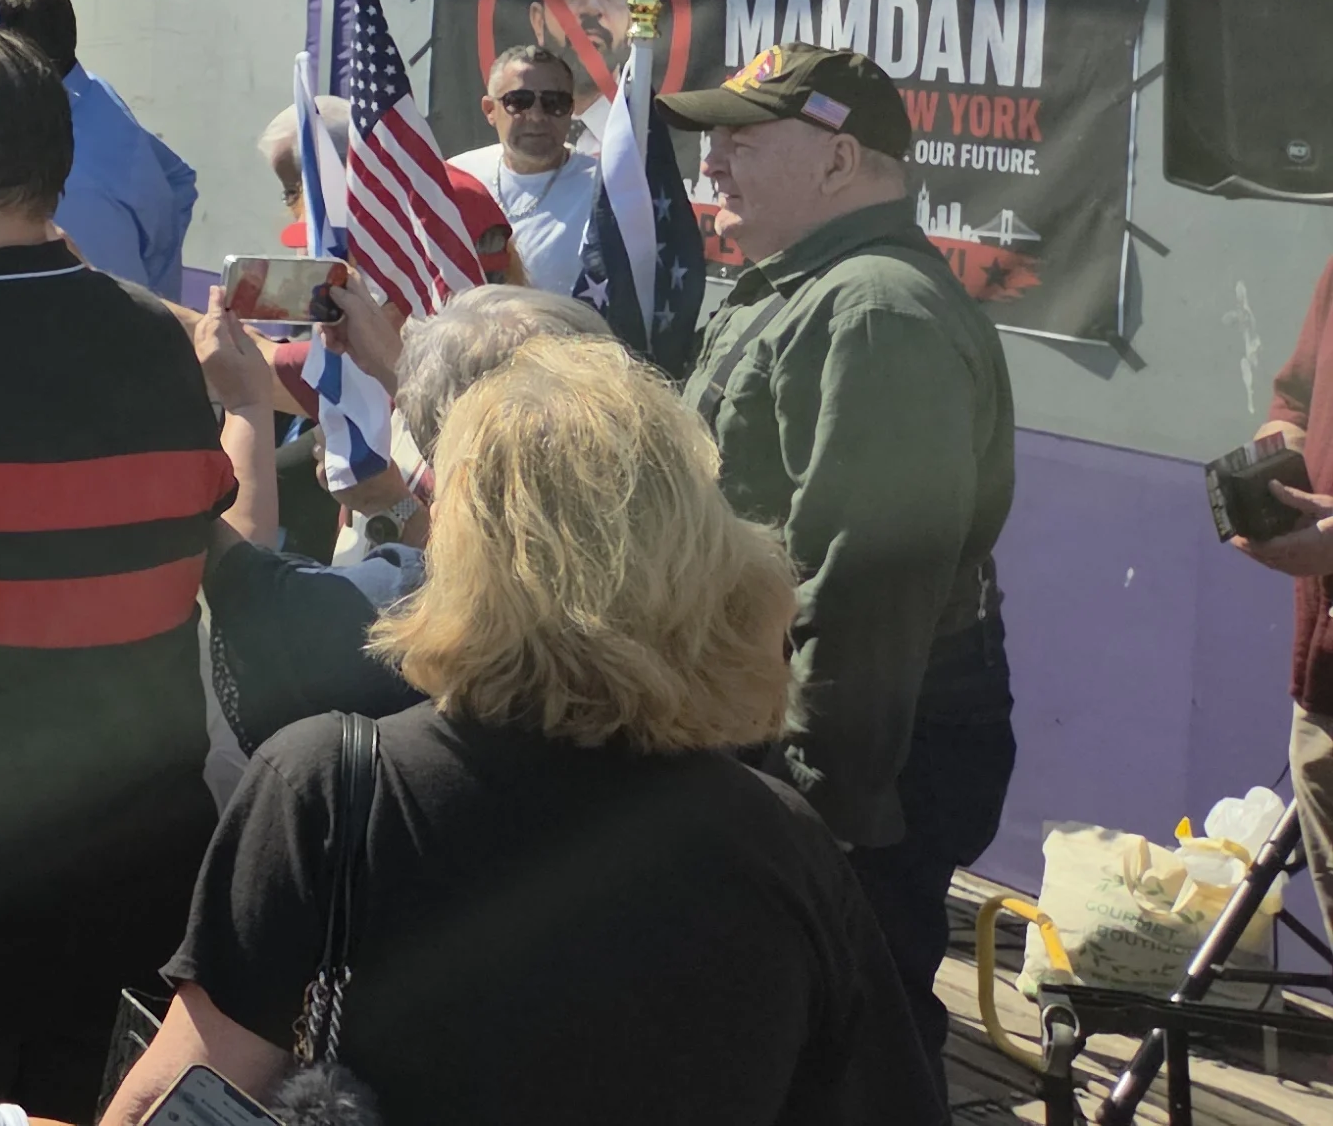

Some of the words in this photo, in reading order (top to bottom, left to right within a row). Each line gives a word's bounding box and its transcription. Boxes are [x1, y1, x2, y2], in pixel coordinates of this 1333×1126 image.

[947, 92, 1043, 143] YORK
[914, 138, 956, 168] OUR
[959, 143, 1042, 176] FUTURE.
[1085, 899, 1180, 941] GOURMET
